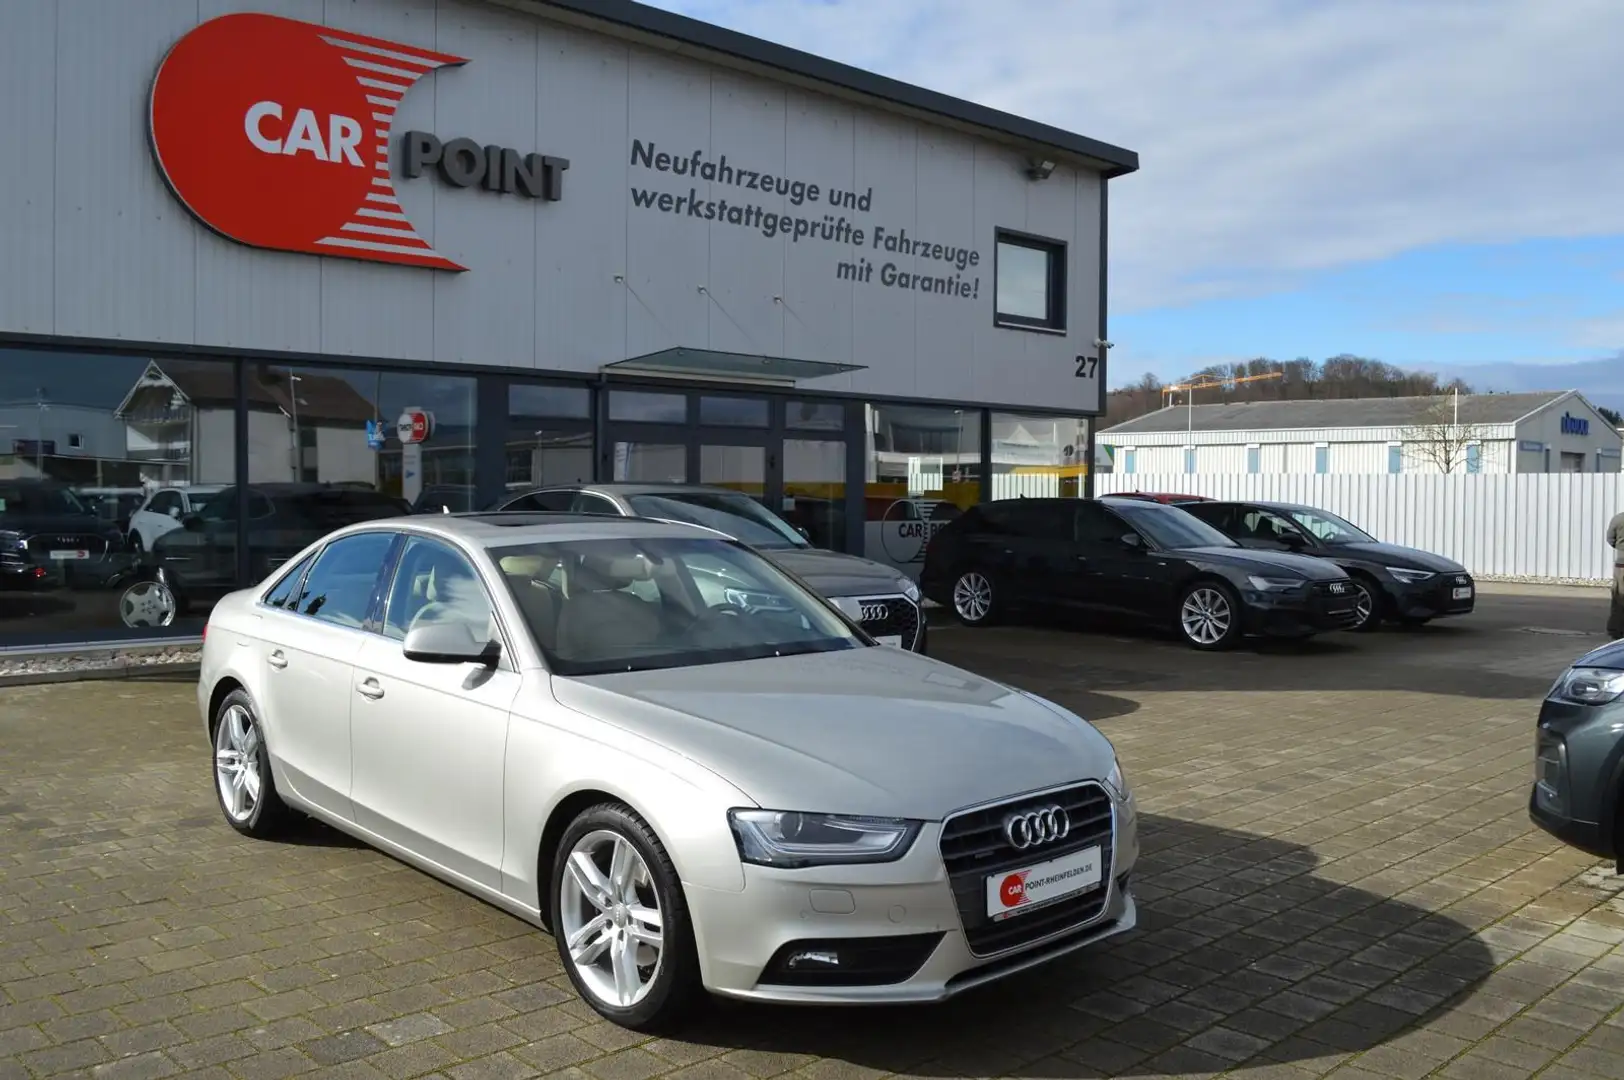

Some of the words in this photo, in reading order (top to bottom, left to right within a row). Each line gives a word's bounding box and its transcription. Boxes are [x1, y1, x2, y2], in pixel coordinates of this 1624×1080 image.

[244, 100, 366, 168] CAR
[403, 130, 570, 202] POINT
[630, 138, 820, 206] Neufahrzeuge
[828, 186, 872, 212] und
[630, 187, 865, 246] werkstattgeprüfte
[872, 226, 980, 271] Fahrzeuge
[836, 257, 873, 283] mit
[880, 262, 980, 300] Garantie!
[1075, 355, 1098, 379] 27
[898, 523, 923, 538] CAR
[1008, 884, 1023, 896] CAR
